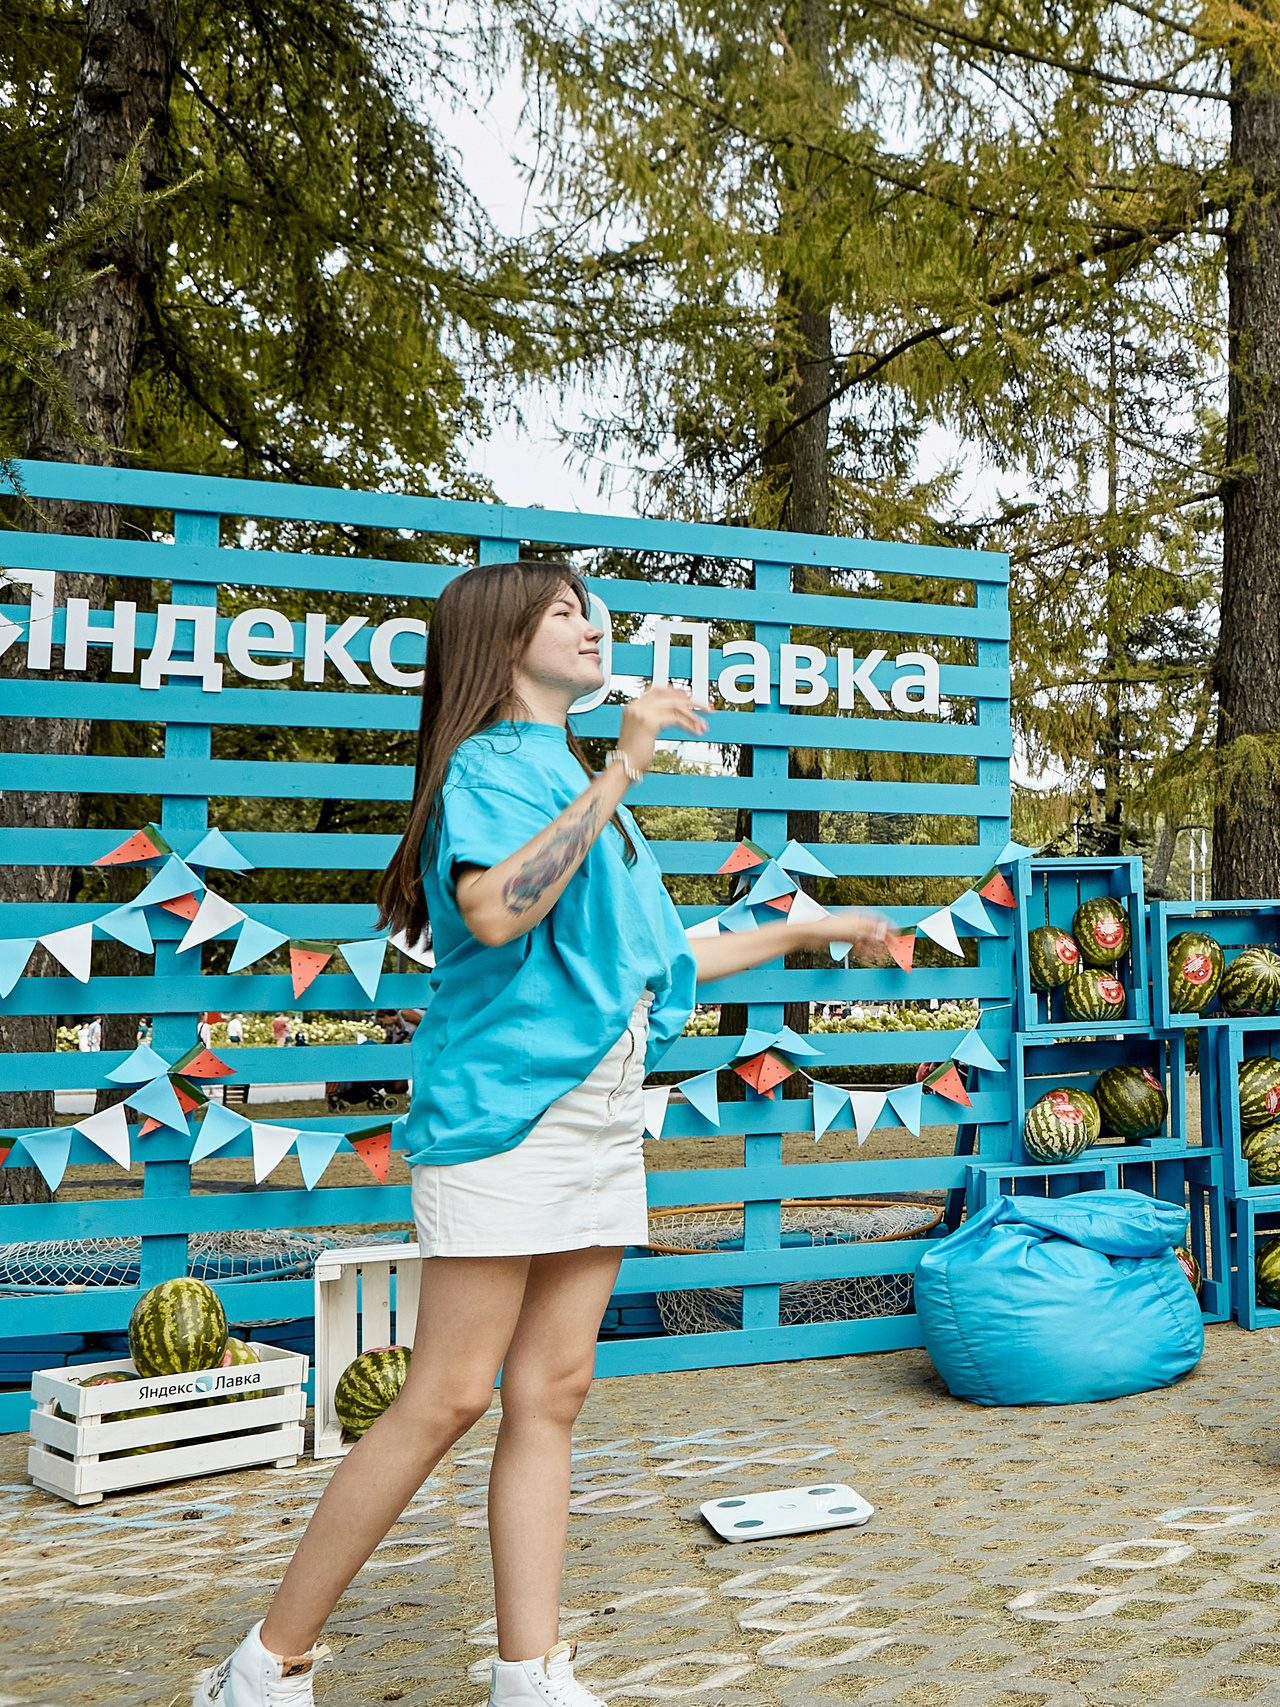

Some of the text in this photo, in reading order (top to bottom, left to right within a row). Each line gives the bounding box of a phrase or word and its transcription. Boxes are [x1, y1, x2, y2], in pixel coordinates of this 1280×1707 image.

[0, 568, 941, 715] Яндекс Лавка
[139, 1373, 261, 1399] Яндекс Лавка
